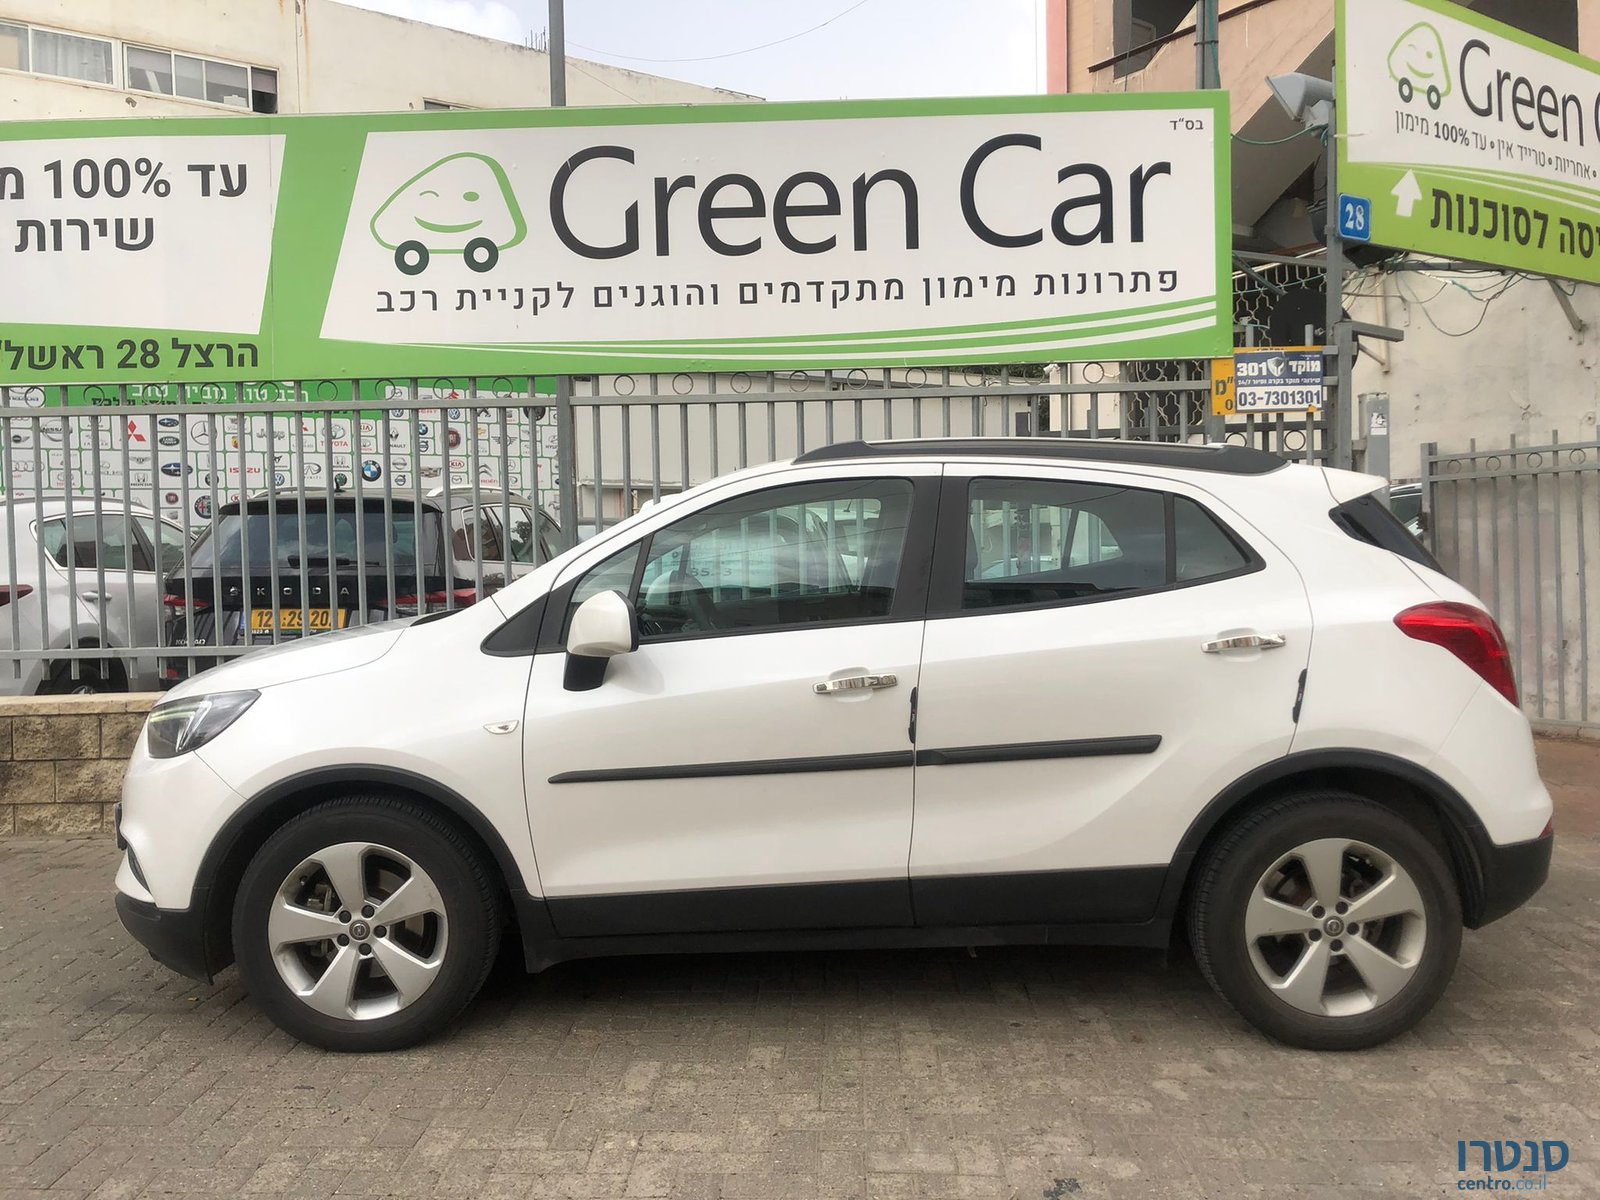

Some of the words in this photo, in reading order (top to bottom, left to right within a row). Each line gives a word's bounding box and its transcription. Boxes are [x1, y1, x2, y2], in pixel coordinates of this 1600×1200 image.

[1459, 38, 1584, 147] Green
[1395, 110, 1429, 136] מימון
[1434, 121, 1470, 147] 100%
[1472, 131, 1487, 151] עד
[1497, 137, 1514, 161] אין
[1517, 144, 1546, 168] טרייד
[1555, 155, 1591, 180] אחריות
[44, 157, 171, 200] 100%
[187, 163, 248, 198] עד
[549, 144, 920, 260] Green
[959, 132, 1172, 249] Car
[1345, 202, 1365, 231] 28
[1431, 187, 1549, 249] לסוכנות
[14, 216, 155, 253] שירות
[593, 283, 719, 309] והוגנים
[739, 277, 905, 310] מתקדמים
[922, 274, 1017, 307] מימון
[1033, 269, 1178, 297] פתרונות
[376, 288, 438, 313] רכב
[455, 281, 575, 316] לקניית
[116, 338, 160, 370] 28
[171, 337, 259, 369] הרצל
[1236, 361, 1267, 377] 301
[1239, 390, 1321, 407] 03-7301301
